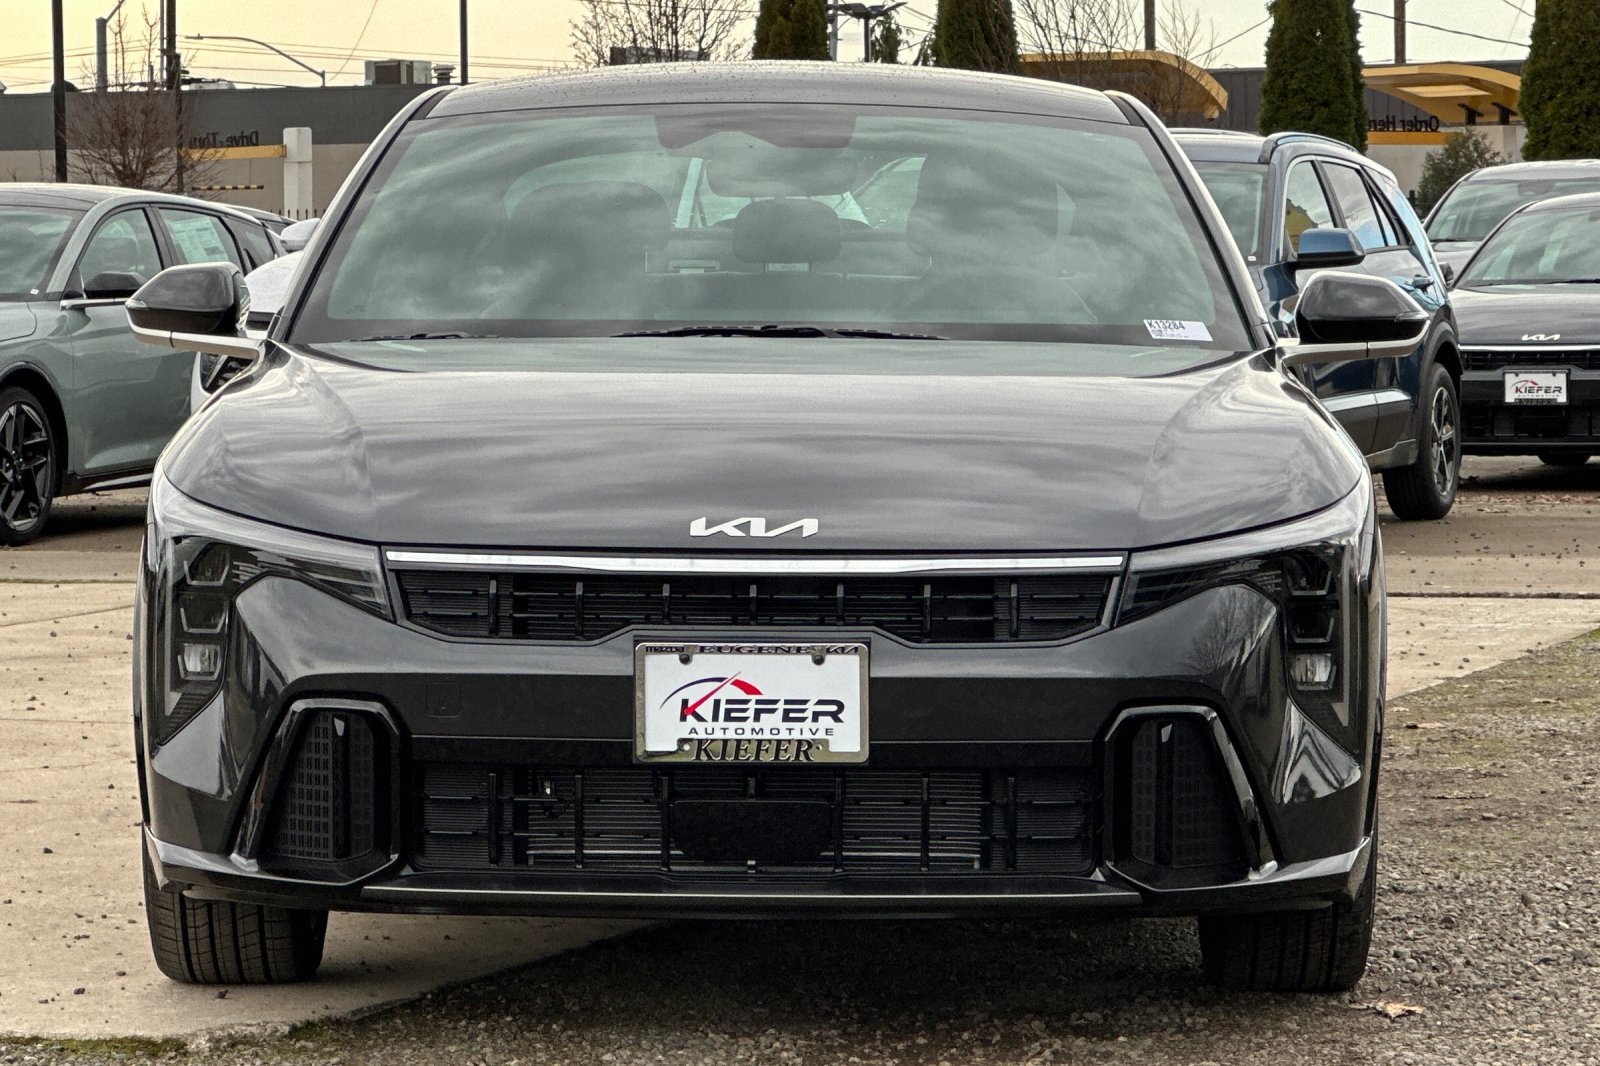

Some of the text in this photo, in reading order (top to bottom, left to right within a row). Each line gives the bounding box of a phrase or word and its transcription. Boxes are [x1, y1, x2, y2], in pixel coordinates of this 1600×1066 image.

[1147, 320, 1186, 330] K13284
[1515, 386, 1562, 394] KIEFER
[689, 516, 819, 538] KIA
[698, 645, 811, 654] EUGENE
[679, 698, 845, 724] KIEFER
[688, 727, 834, 736] AUTOMOTIVE
[692, 738, 815, 762] KIEFER
